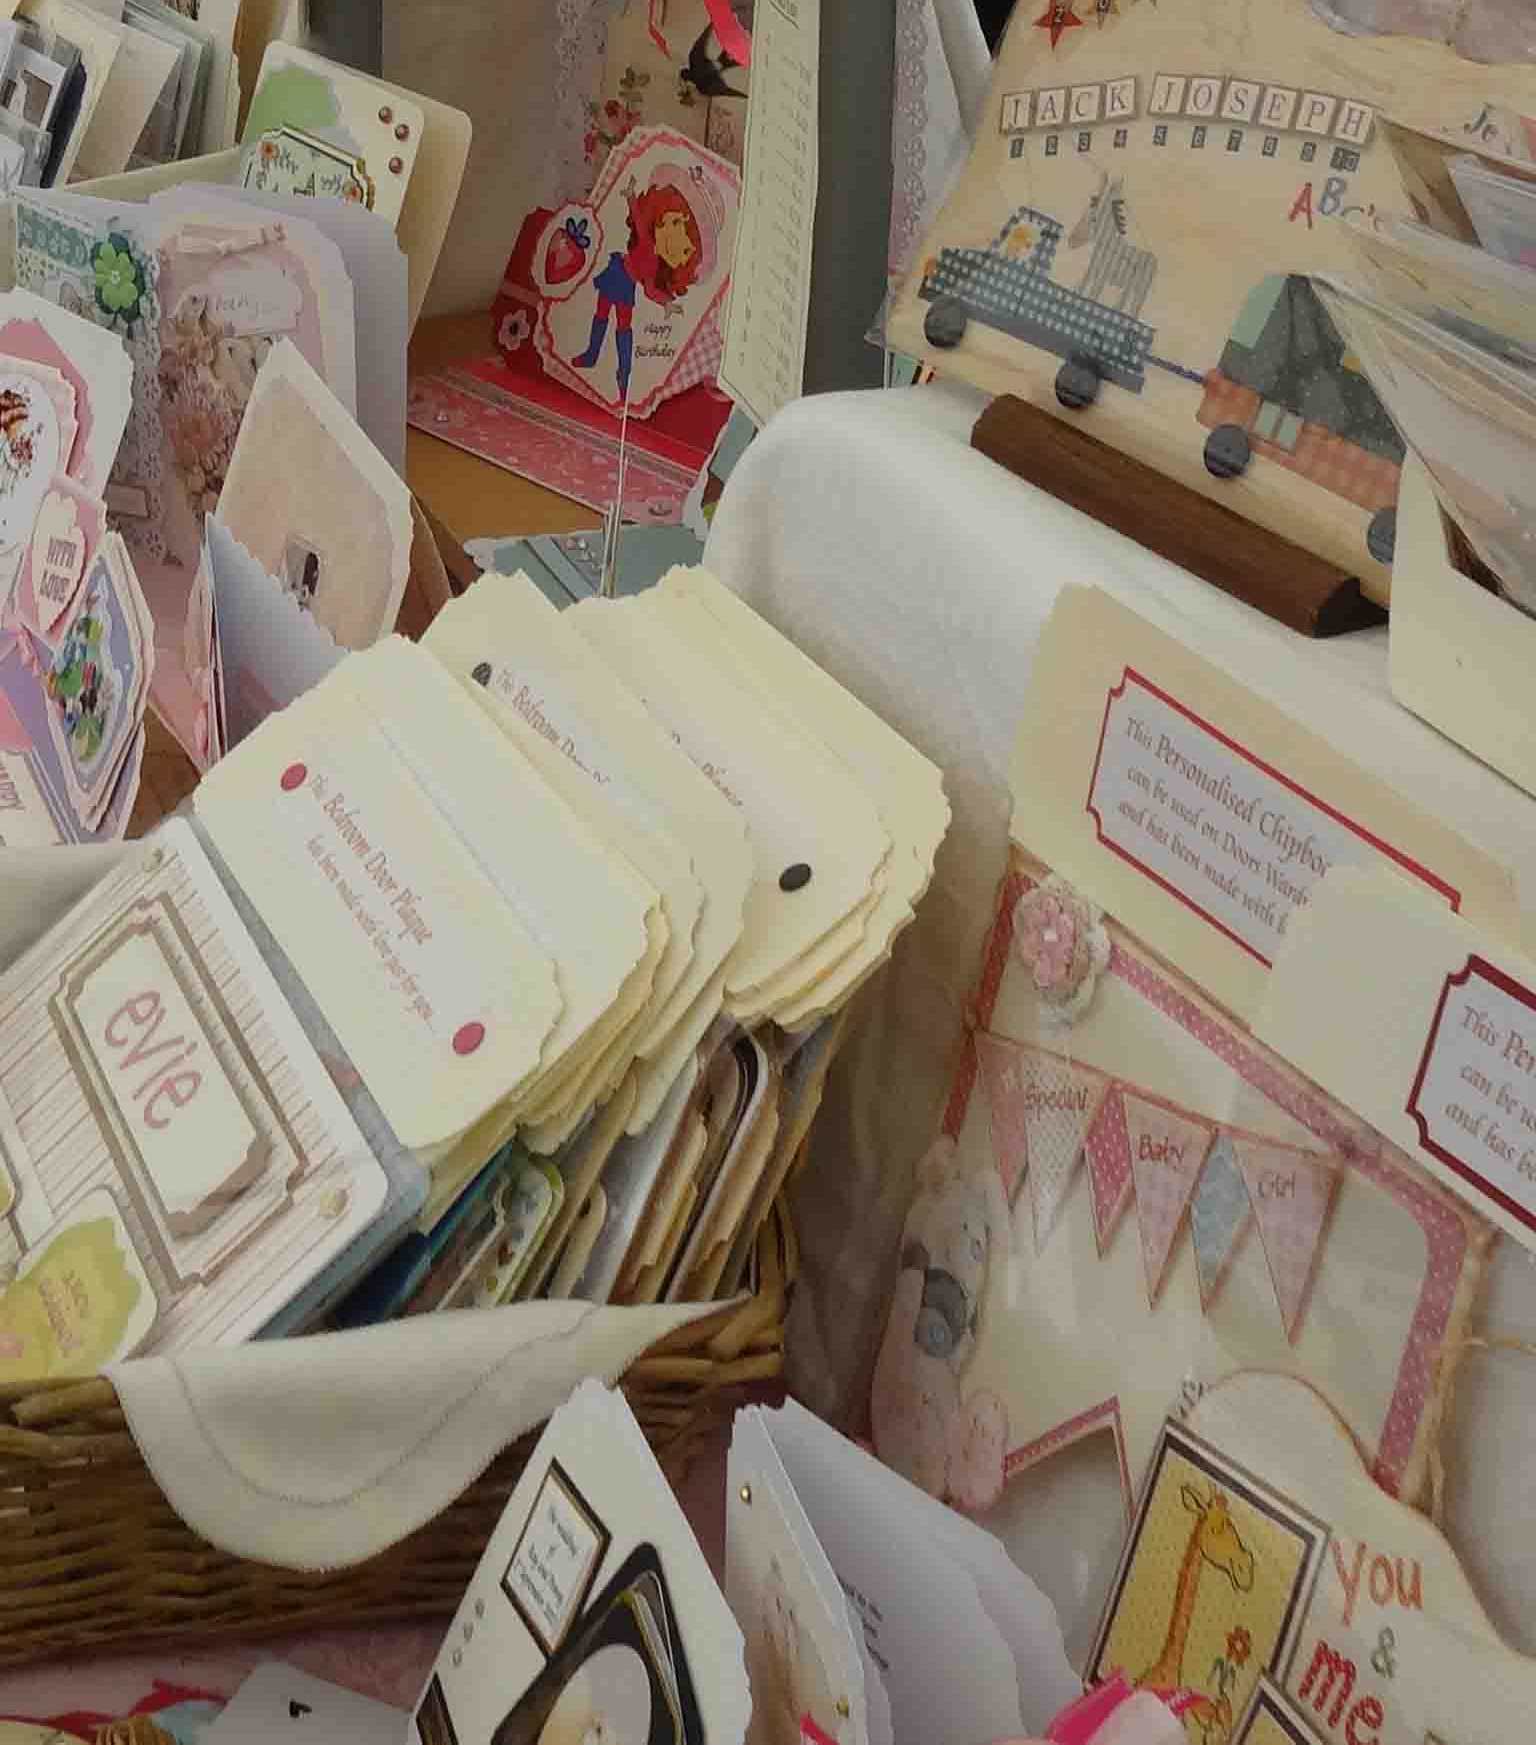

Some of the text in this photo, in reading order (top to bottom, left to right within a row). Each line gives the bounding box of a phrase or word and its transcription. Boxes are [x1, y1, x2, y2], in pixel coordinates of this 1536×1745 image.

[1009, 78, 1370, 139] JACK JOSEPH
[1153, 733, 1262, 825] Personalised
[1461, 1004, 1499, 1048] This
[103, 988, 203, 1132] evie
[1023, 1085, 1089, 1121] Special
[1460, 1063, 1493, 1099] can
[1495, 1080, 1519, 1116] be
[1138, 1133, 1185, 1171] Baby
[1444, 1101, 1489, 1140] and
[1484, 1121, 1516, 1162] has
